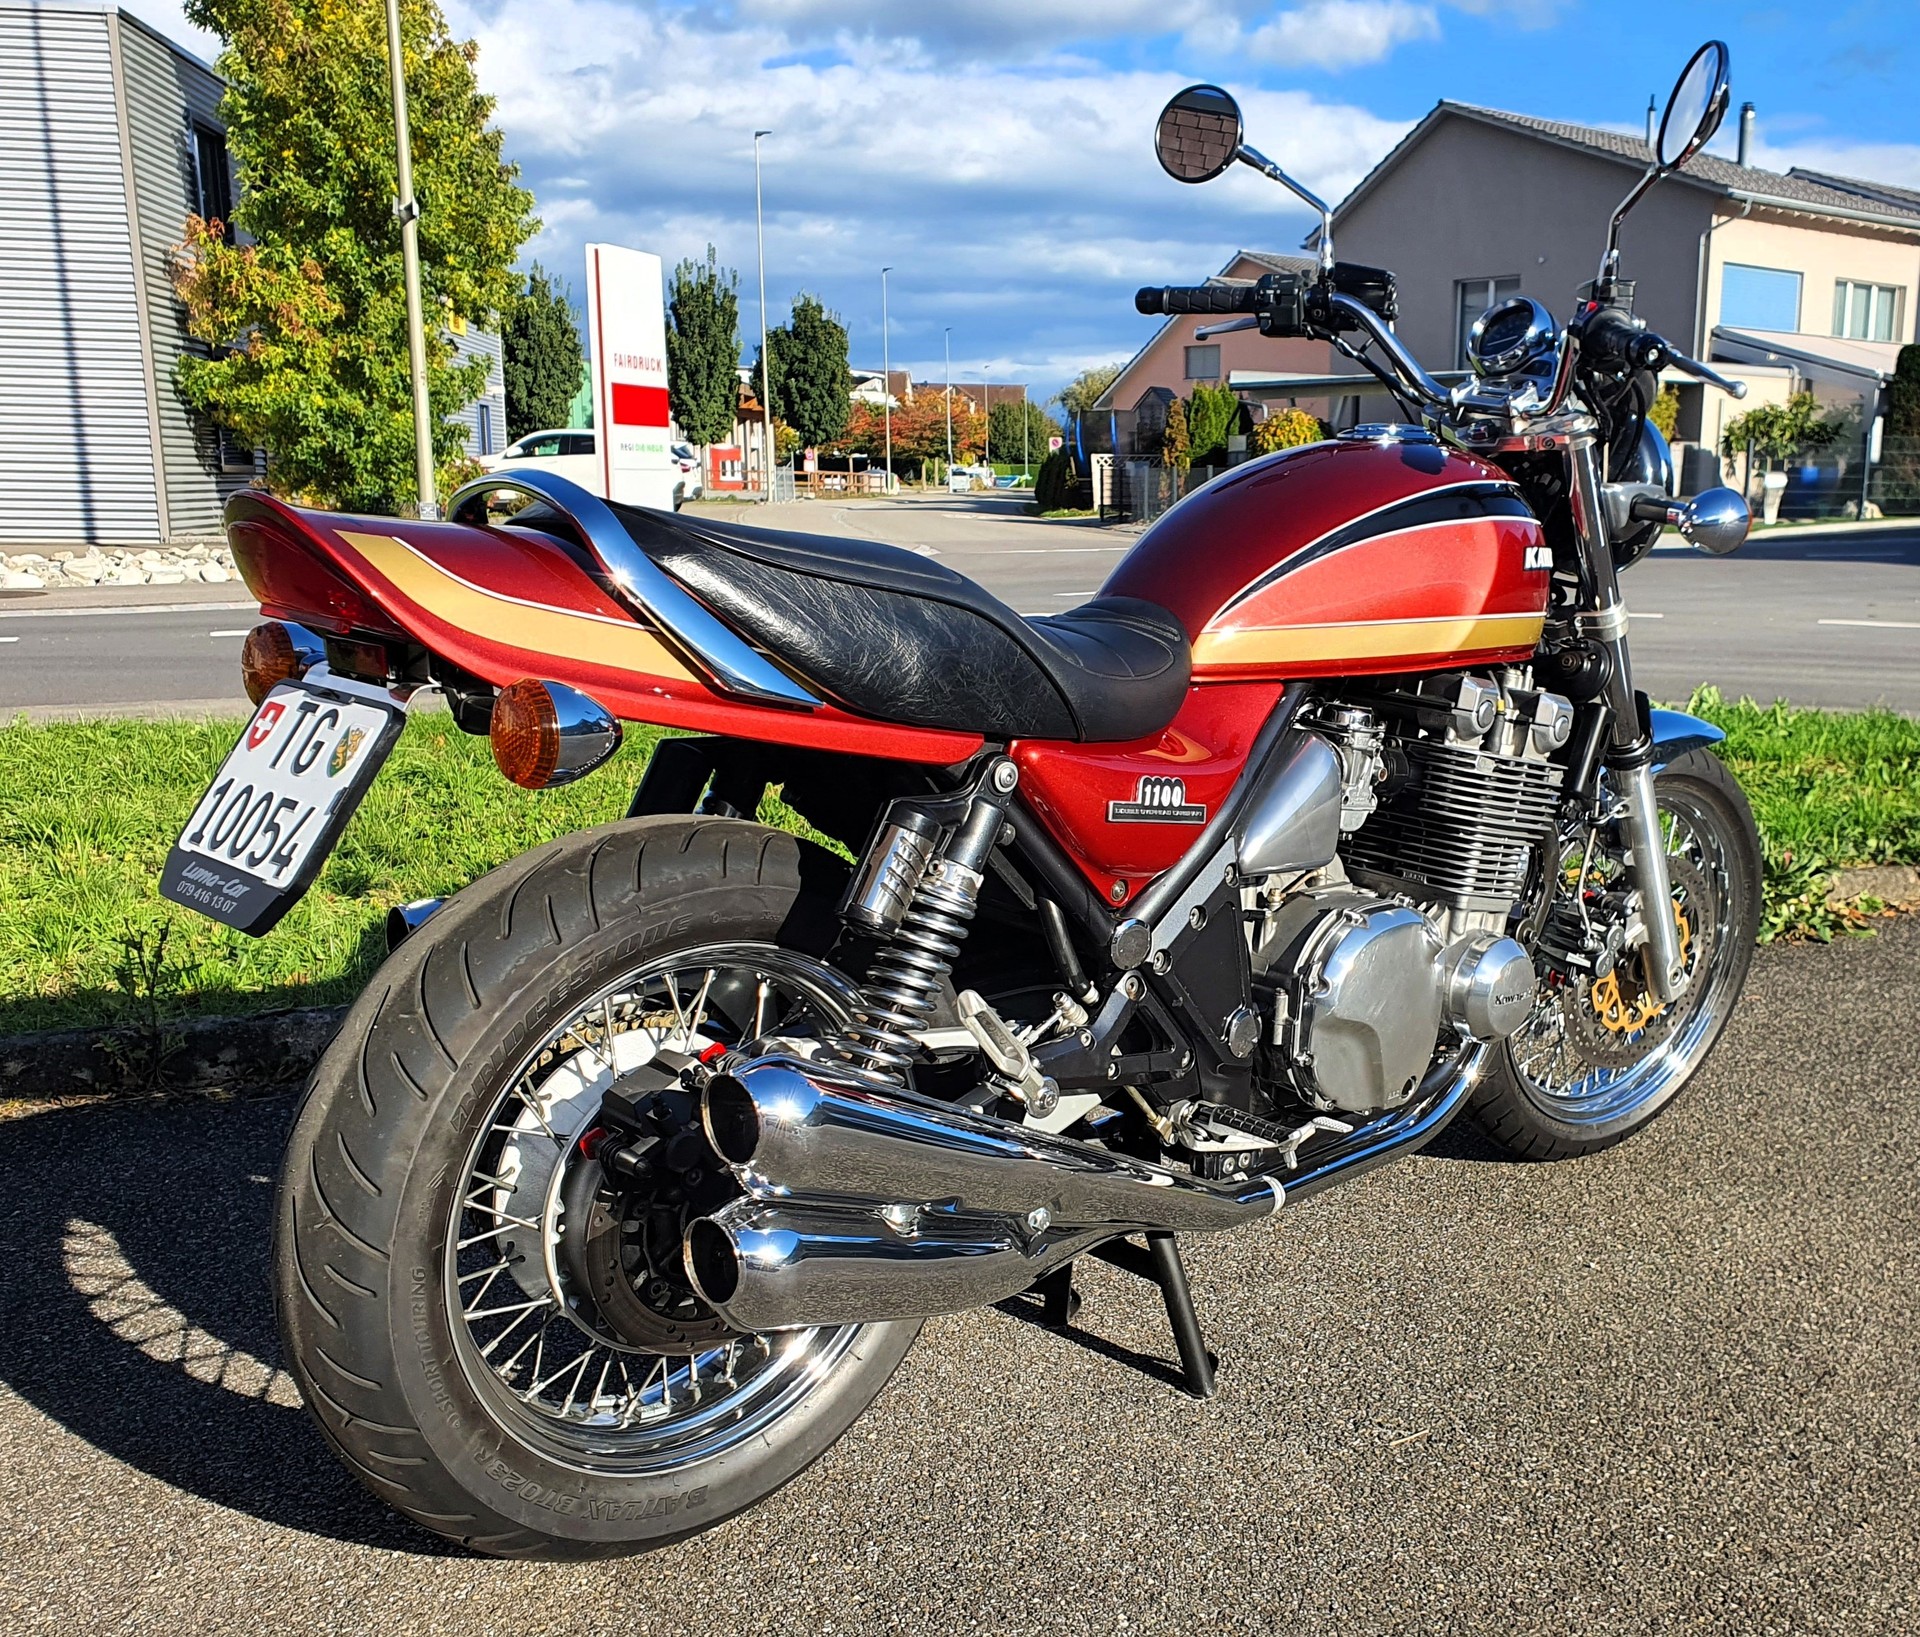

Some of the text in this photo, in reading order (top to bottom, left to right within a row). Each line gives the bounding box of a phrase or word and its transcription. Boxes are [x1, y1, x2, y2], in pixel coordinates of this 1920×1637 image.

[614, 352, 662, 372] FAIRDRUCK
[269, 700, 340, 777] TG
[1143, 784, 1182, 808] 1100
[187, 777, 316, 880] 10054
[176, 880, 238, 914] 079 416 13 07
[181, 861, 251, 898] Luma-Car
[410, 1267, 433, 1357] TOURING
[420, 1360, 456, 1414] SPORT
